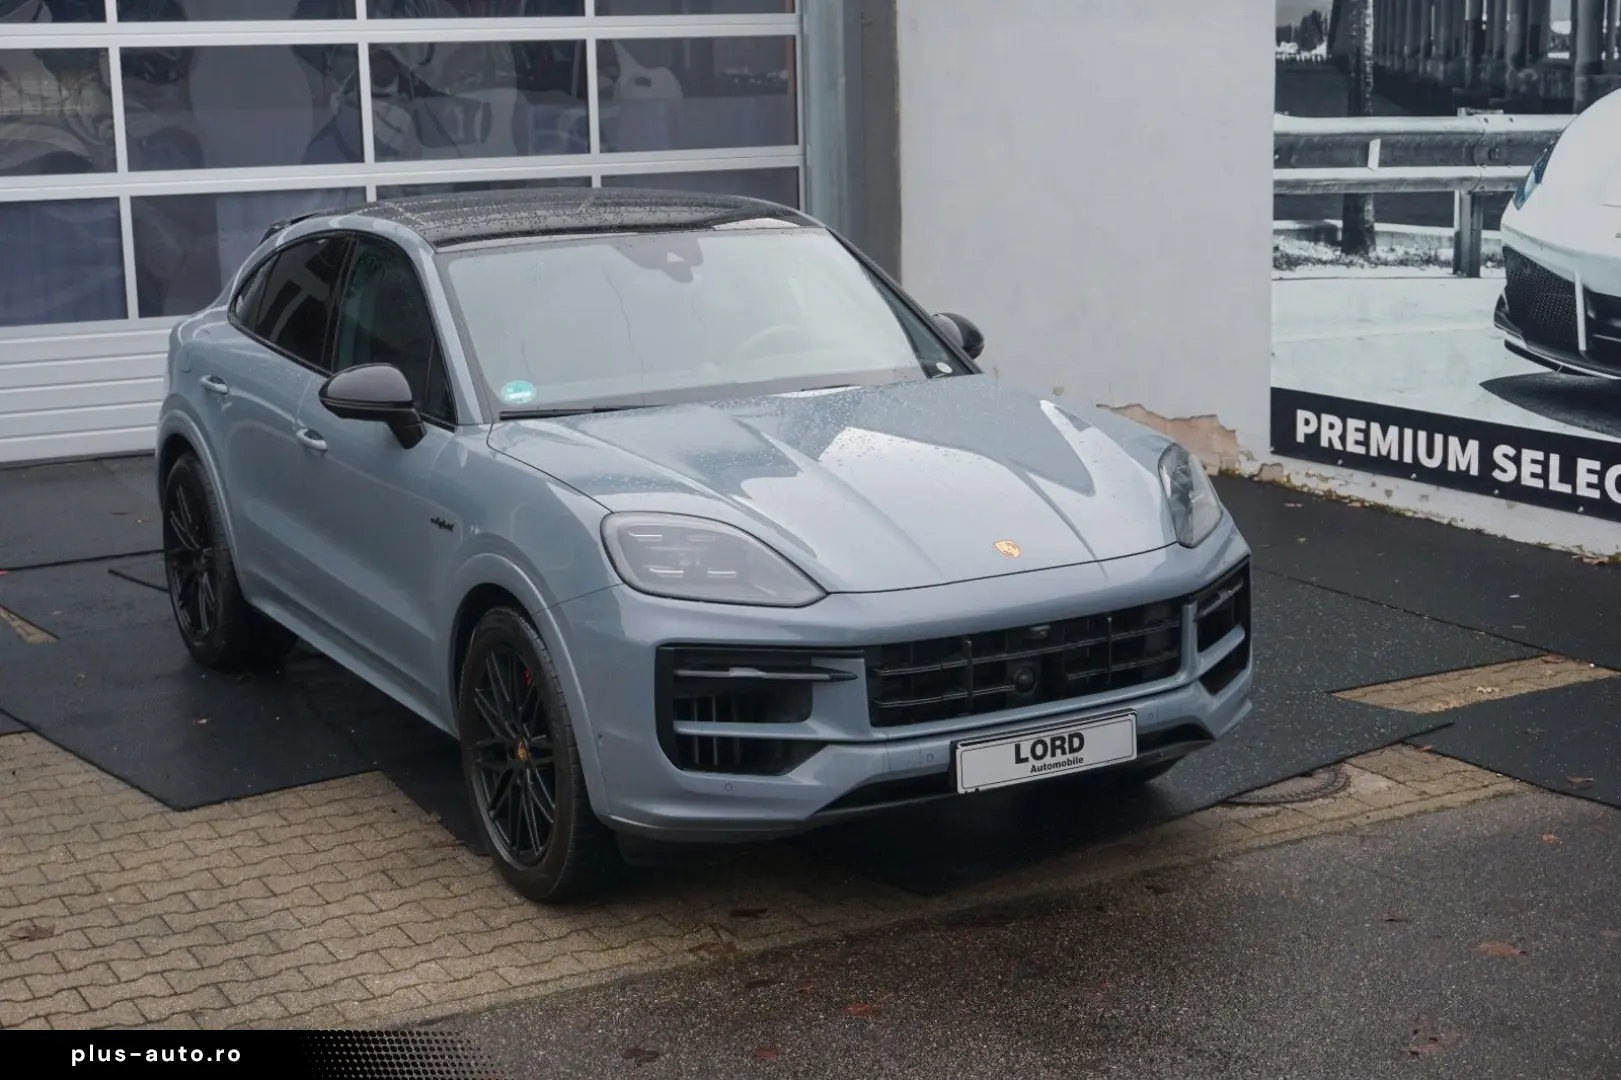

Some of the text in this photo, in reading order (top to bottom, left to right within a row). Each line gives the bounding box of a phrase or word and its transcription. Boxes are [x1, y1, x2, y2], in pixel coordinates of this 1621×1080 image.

[1296, 409, 1480, 476] PREMIUM
[1014, 732, 1085, 765] LORD
[1030, 757, 1084, 773] Automobile
